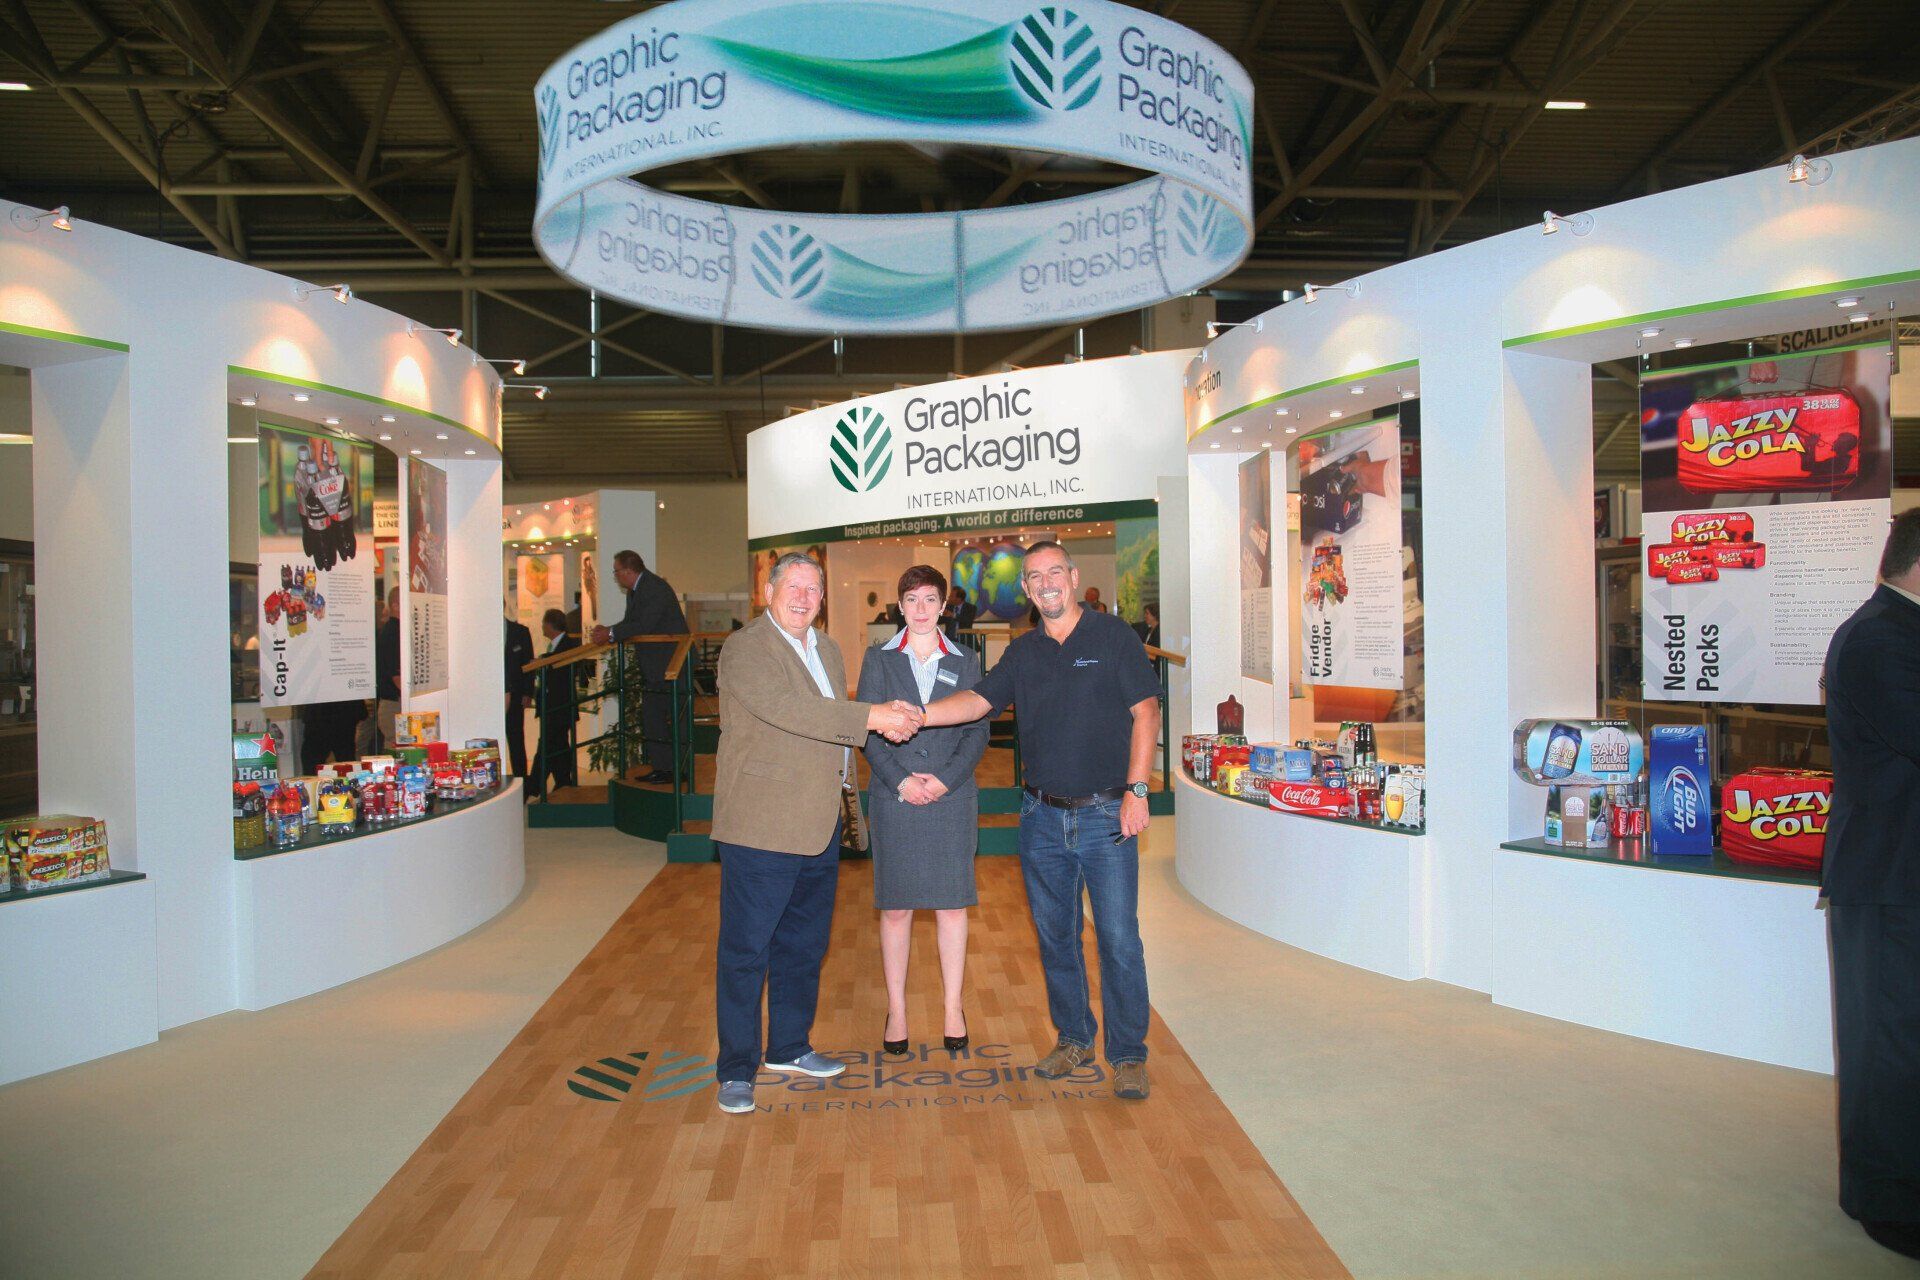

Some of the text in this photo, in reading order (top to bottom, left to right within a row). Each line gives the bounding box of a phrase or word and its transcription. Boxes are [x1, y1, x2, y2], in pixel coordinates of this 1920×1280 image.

[567, 27, 680, 100] Graphic
[1118, 25, 1224, 104] Graphic
[566, 70, 728, 149] Packaging
[1118, 73, 1242, 171] Packaging
[904, 382, 1033, 434] Graphic
[1681, 408, 1799, 453] JAZZY
[906, 427, 1082, 477] Packaging
[1707, 432, 1806, 467] COLA
[906, 476, 1085, 510] INTERNATIONAL, INC.
[844, 506, 1085, 538] Inspired packaging. A world of difference
[1684, 530, 1730, 543] COLA
[273, 638, 290, 698] Cap-It
[1310, 624, 1320, 677] Fridge
[1322, 618, 1332, 677] Vendor
[1663, 614, 1686, 691] Nested
[1696, 623, 1720, 692] Packs
[1591, 742, 1629, 756] SAND
[1591, 755, 1629, 764] DOLLAR
[1281, 785, 1322, 806] Coca-Cola
[1672, 775, 1685, 834] LIGHT
[1684, 785, 1697, 829] BUD
[1750, 815, 1829, 840] COL
[754, 1092, 1043, 1113] NTERNATIONAL,
